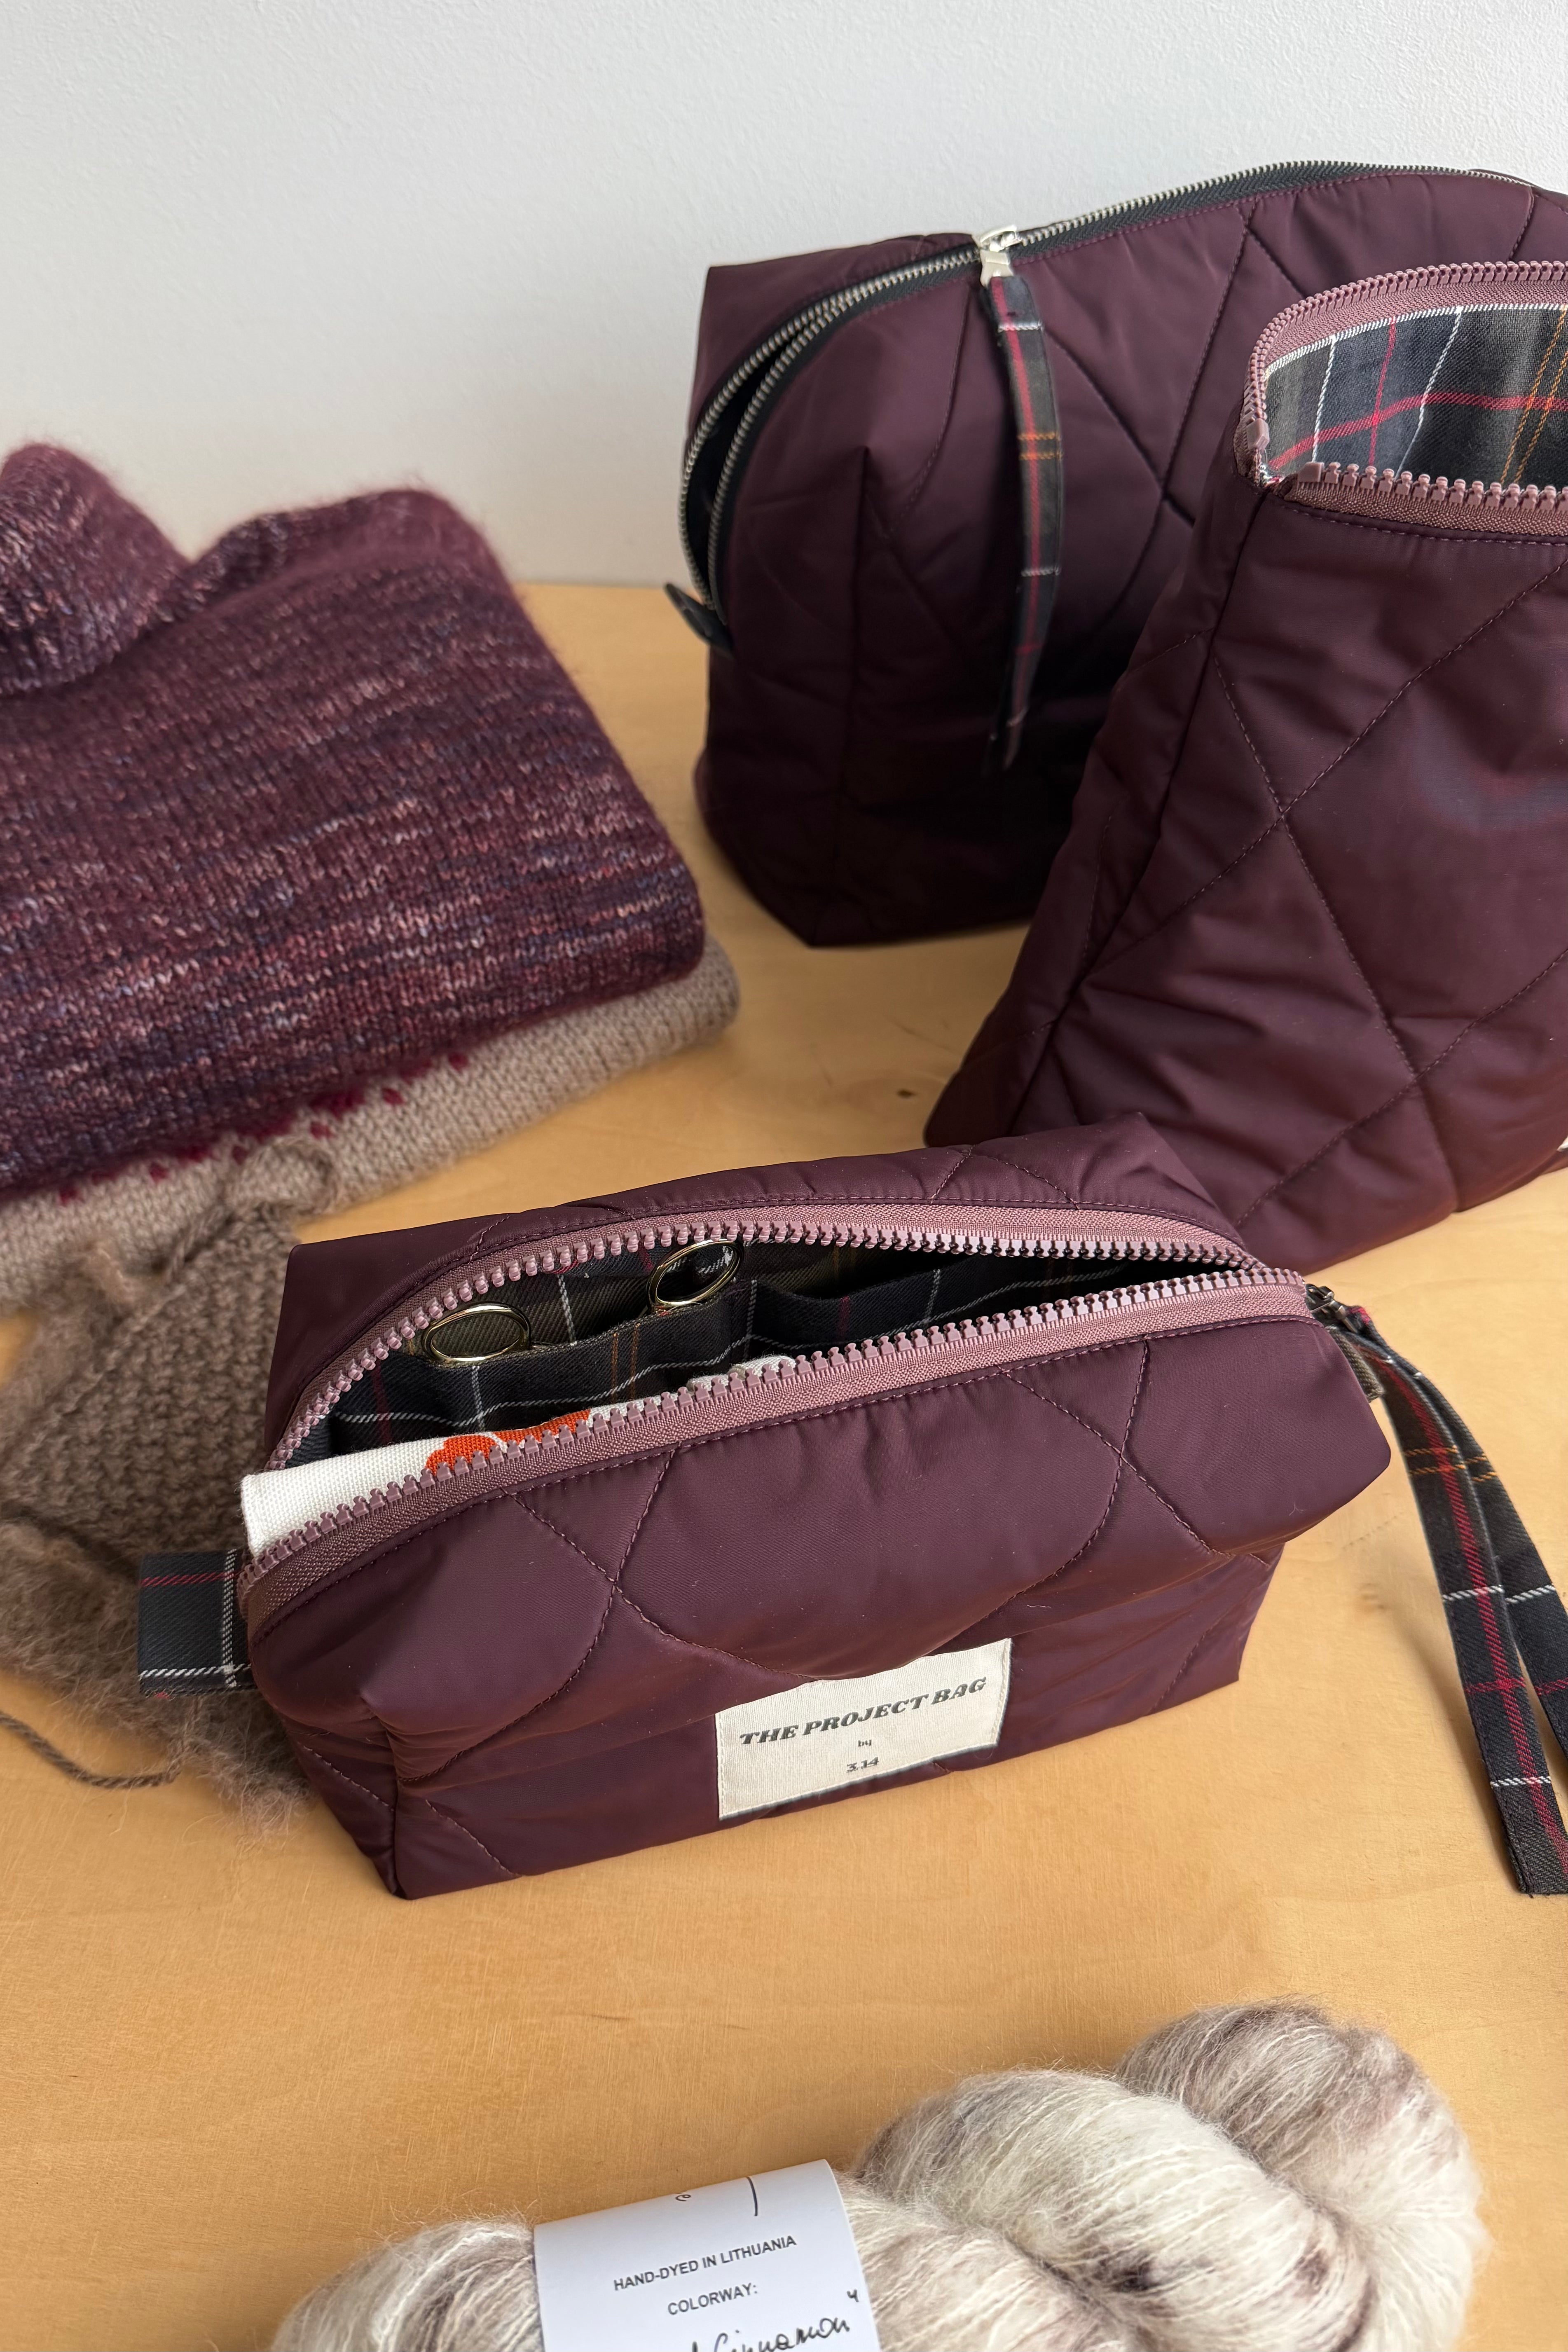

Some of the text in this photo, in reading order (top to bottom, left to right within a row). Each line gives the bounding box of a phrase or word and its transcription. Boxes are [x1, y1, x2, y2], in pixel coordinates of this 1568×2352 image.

[740, 1676, 987, 1745] THE PROJECT BAG
[846, 1756, 880, 1773] 3.14
[613, 2235, 797, 2291] HAND-DYED IN LITHUANIA
[667, 2282, 758, 2315] COLORWAY:
